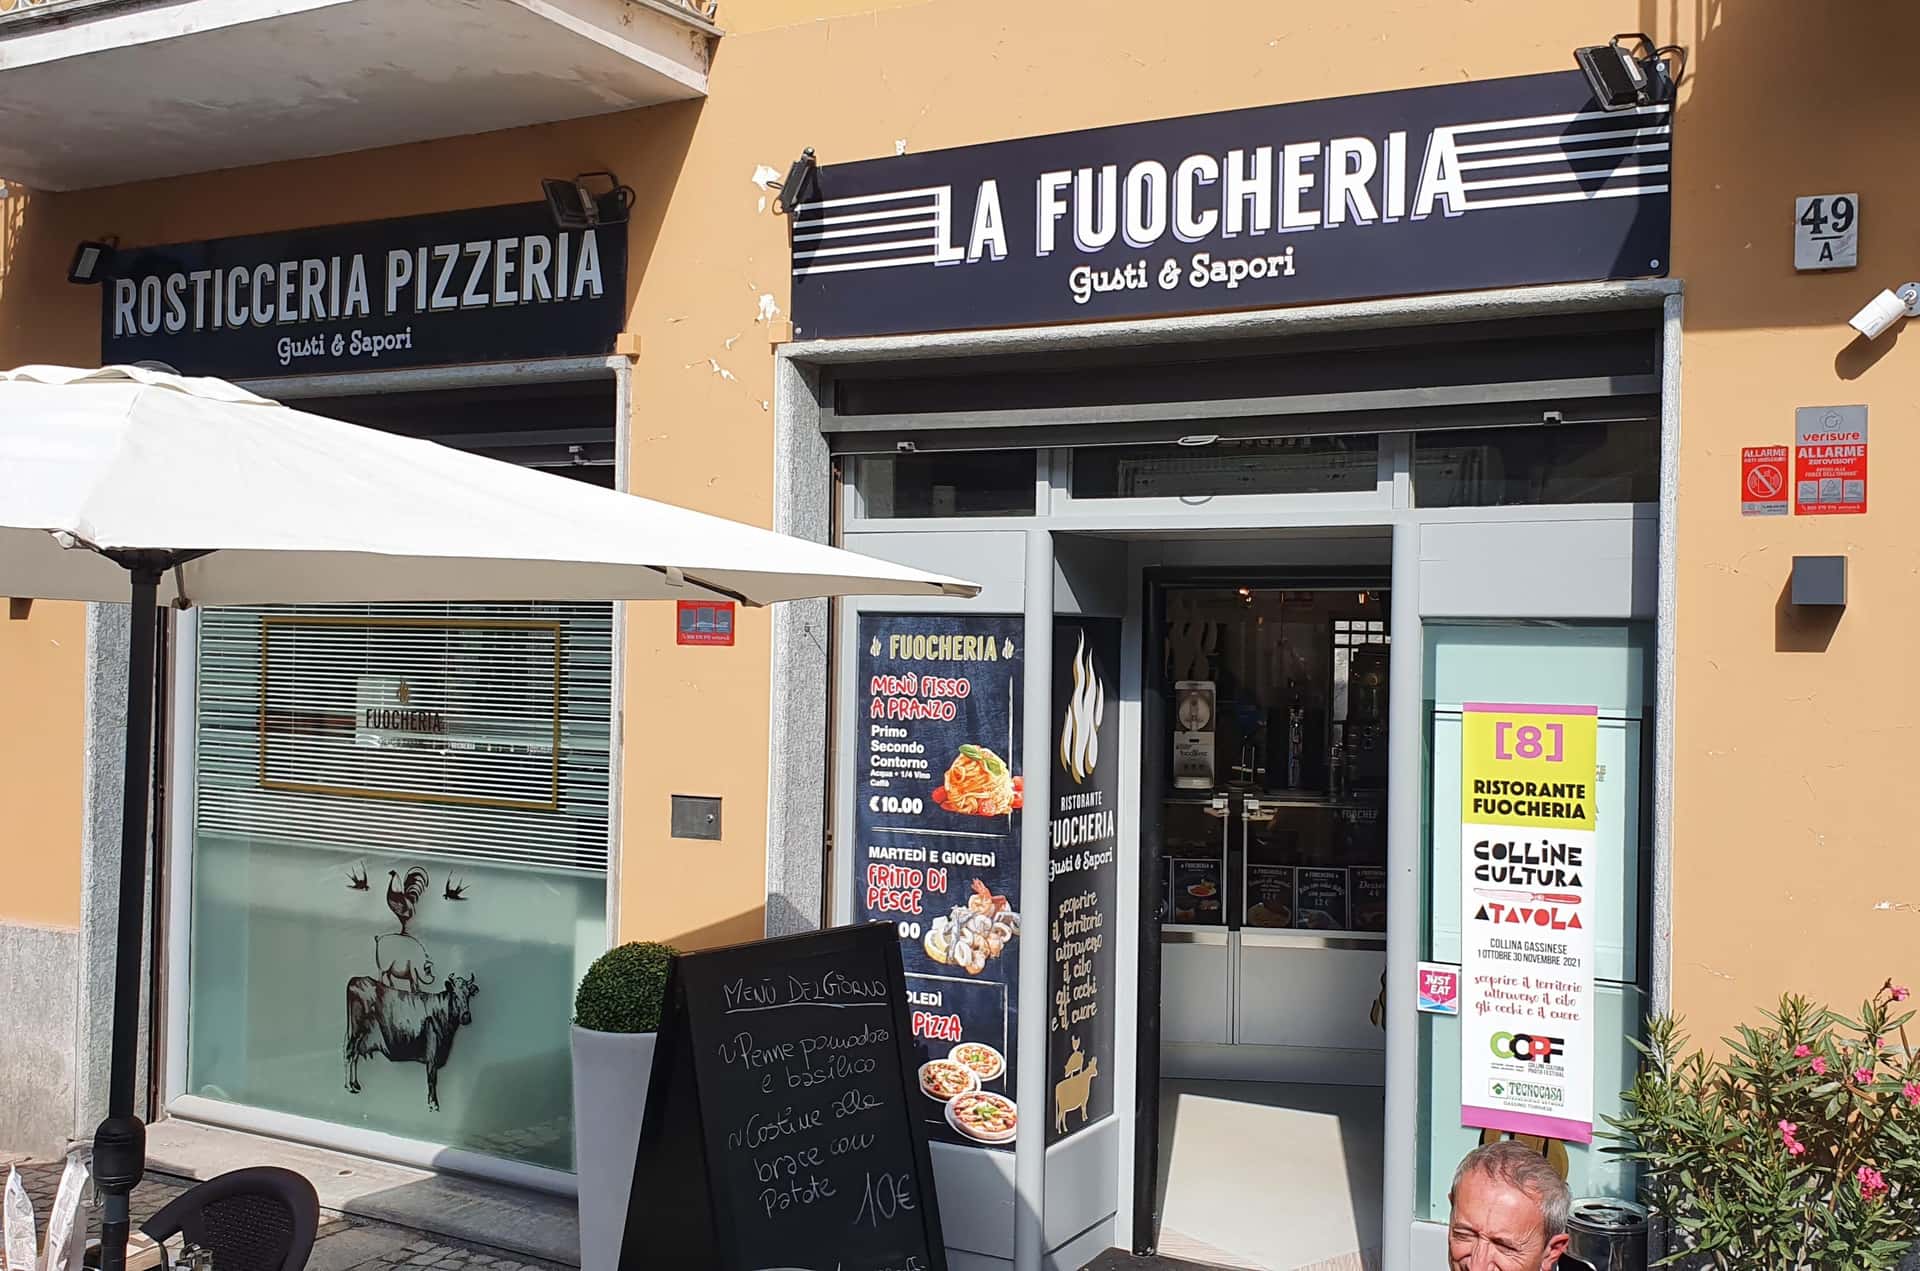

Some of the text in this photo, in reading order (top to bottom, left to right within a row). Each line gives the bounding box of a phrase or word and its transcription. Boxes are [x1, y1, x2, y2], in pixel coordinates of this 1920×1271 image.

[935, 128, 1466, 265] LA FUOCHERIA
[1800, 197, 1854, 235] 49
[1819, 242, 1833, 262] A
[113, 229, 603, 337] ROSTICCERIA PIZZERIA
[1069, 247, 1296, 304] Gusti & Sapori
[277, 327, 412, 364] Gusti & Sapori
[1803, 431, 1860, 441] verisure
[1744, 448, 1786, 457] ALLARME
[1798, 446, 1865, 458] ALLARME
[889, 634, 998, 661] FUOCHERIA
[871, 672, 970, 699] MENÙ FISSO
[365, 707, 443, 732] FUOCHERIA
[870, 697, 956, 720] A PRANZO
[871, 724, 908, 738] Primo
[870, 740, 925, 754] Secondo
[870, 754, 928, 769] Contorno
[870, 769, 931, 779] Acqua 1/4 Vino
[1060, 791, 1103, 811] RISTORANTE
[1473, 779, 1586, 800] RISTORANTE
[1473, 798, 1586, 820] FUOCHERIA
[869, 846, 995, 867] MARTEDÌ E GIOVEDÌ
[1083, 847, 1113, 870] Sapori
[1474, 864, 1583, 888] CULTURA
[866, 888, 923, 914] PESCE
[1059, 889, 1098, 921] scoprire
[1052, 911, 1103, 943] il territorio
[1056, 933, 1103, 962] attraverso
[1490, 938, 1568, 955] COLLINA GASSINESE
[1063, 955, 1092, 984] il cibo
[1477, 949, 1581, 968] 1 OTTOBRE 30 NOVEMBRE 2021
[1424, 974, 1451, 985] JUST
[1430, 984, 1451, 995] EAT
[1474, 975, 1583, 992] scoprire il territorio
[1056, 976, 1097, 1016] gli occhi
[1484, 989, 1576, 1006] attraverso il cibo
[1050, 1016, 1059, 1032] e
[1071, 1002, 1097, 1024] cuore
[1475, 1000, 1491, 1016] gli
[1495, 1002, 1523, 1015] occhi
[1538, 1006, 1546, 1019] il
[1550, 1010, 1581, 1020] cuore
[734, 1023, 889, 1071] Penne pomodoro
[761, 1054, 876, 1093] e basilico
[1509, 1081, 1562, 1102] TECNOCASA
[747, 1107, 824, 1149] Costine
[753, 1148, 825, 1183] brace
